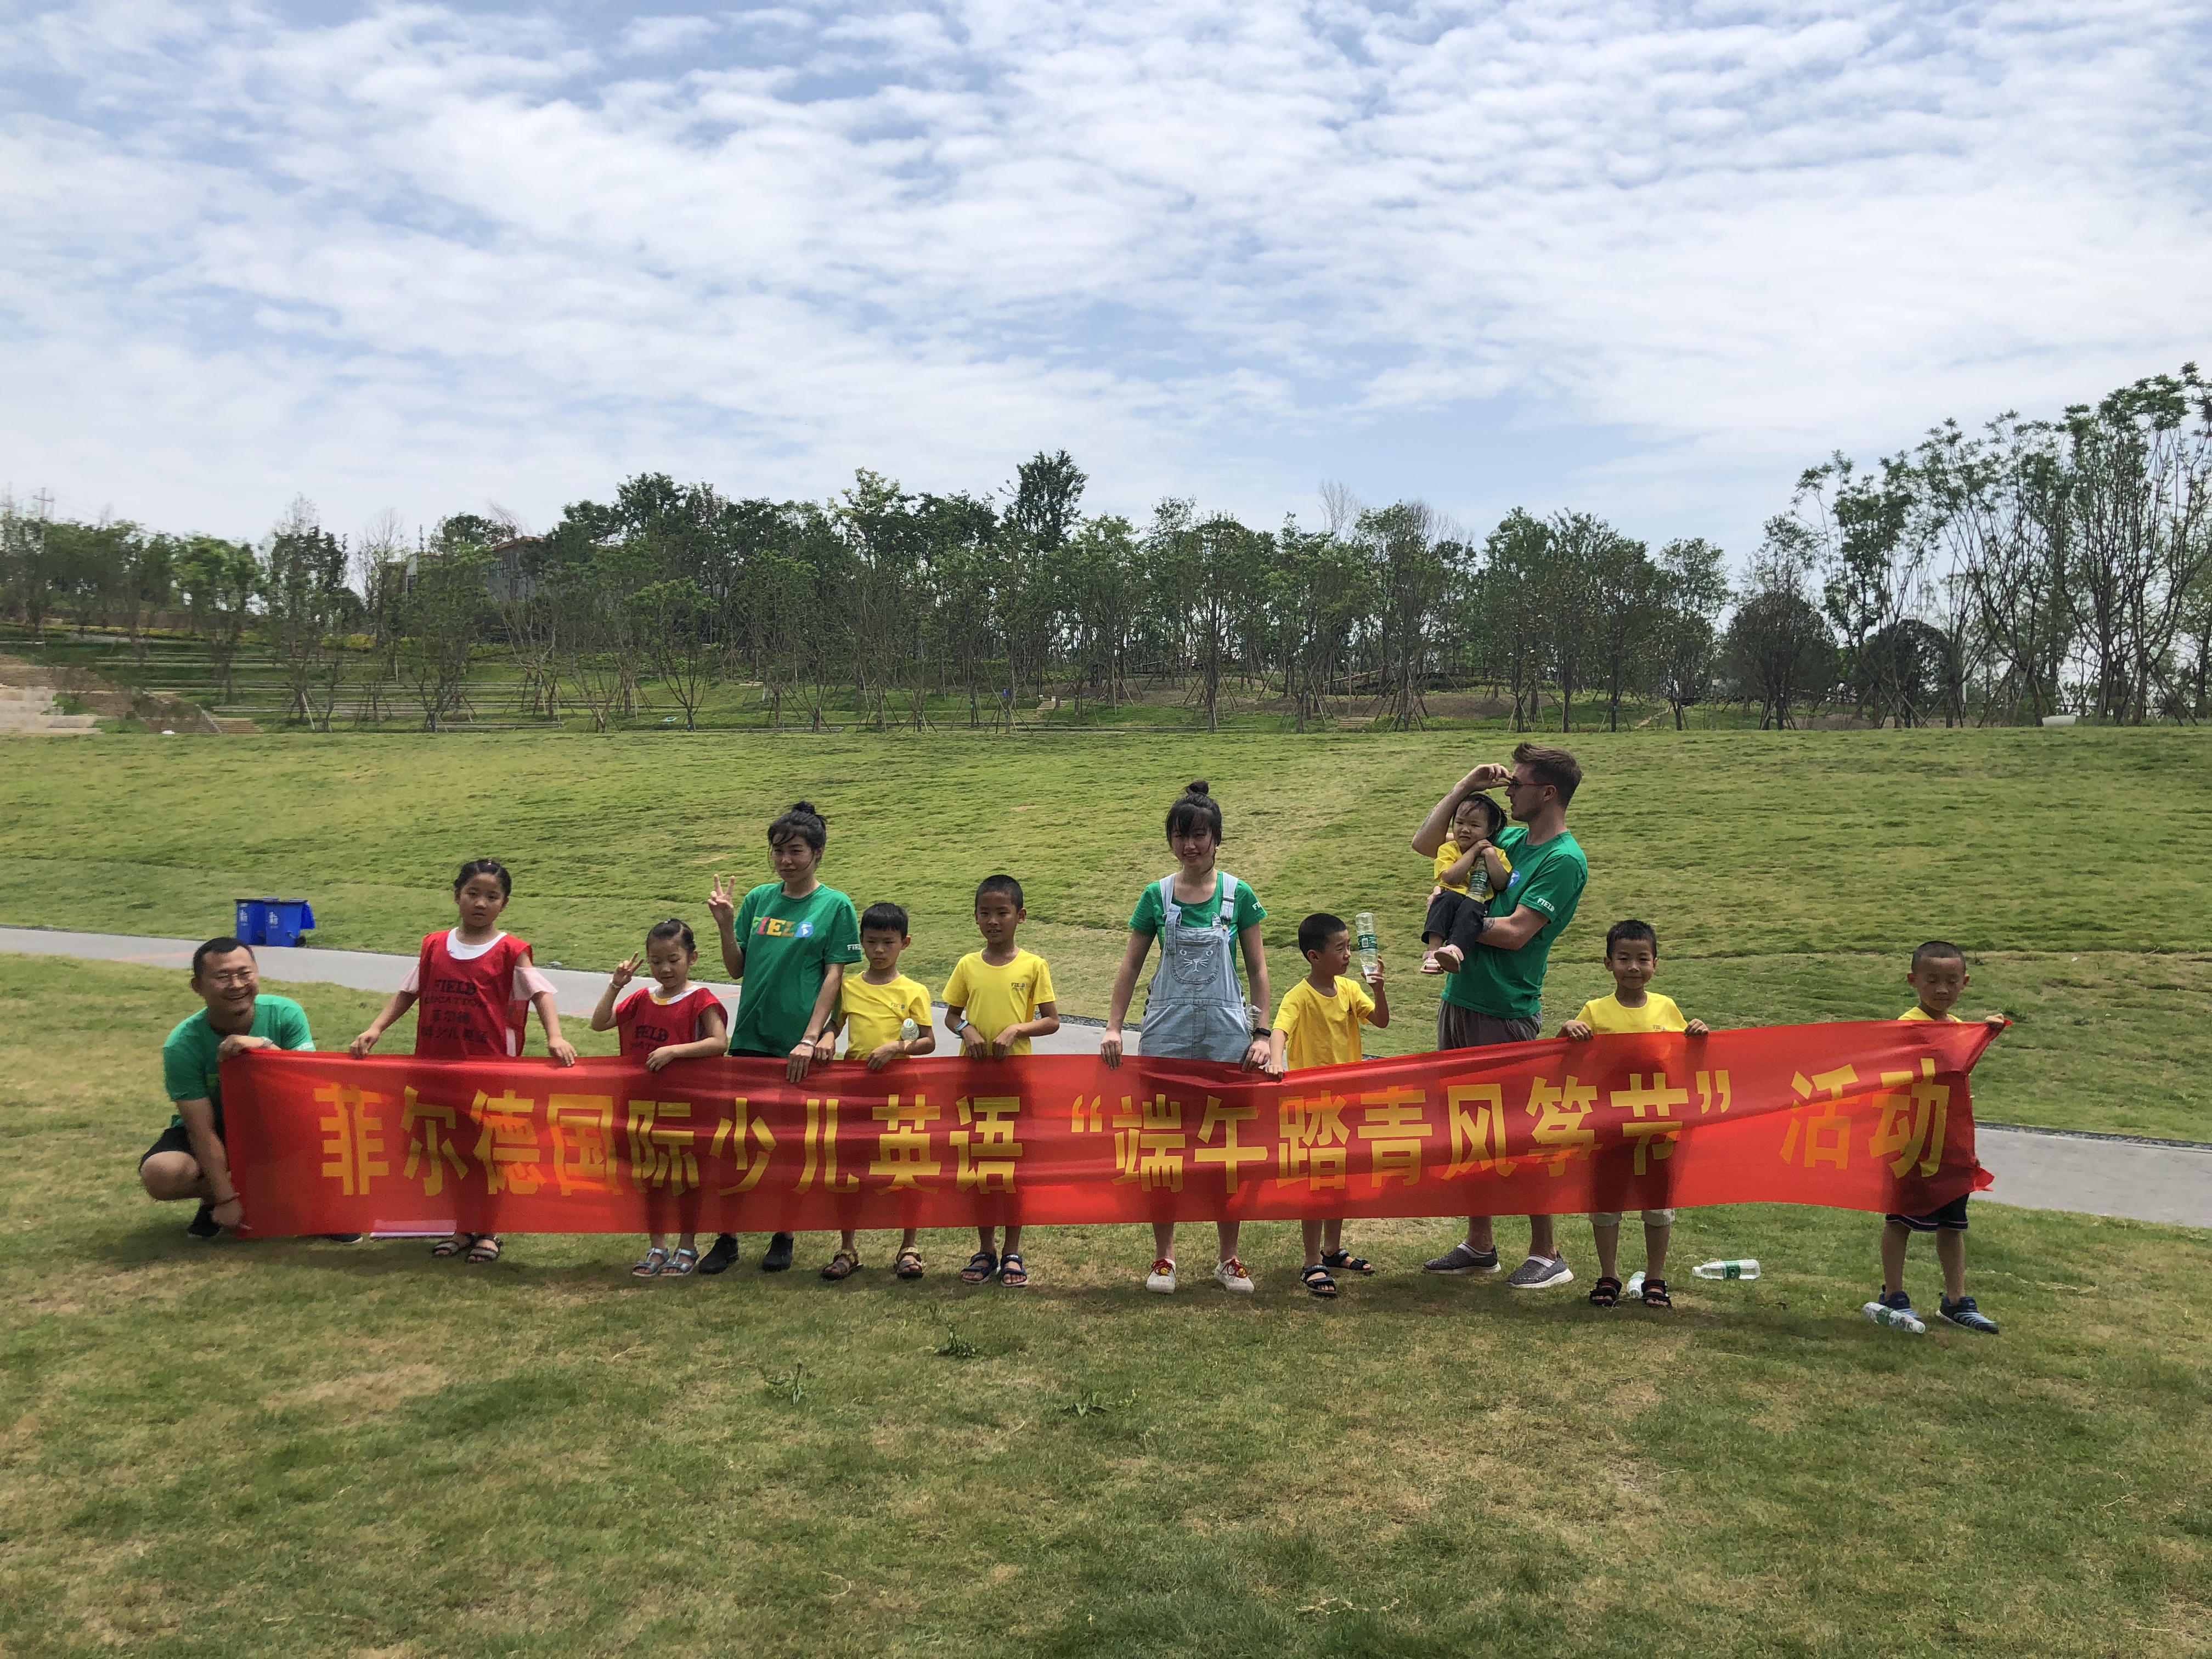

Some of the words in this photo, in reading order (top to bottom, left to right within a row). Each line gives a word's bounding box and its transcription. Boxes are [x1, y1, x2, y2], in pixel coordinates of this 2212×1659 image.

[1537, 898, 1554, 912] FIELD
[752, 916, 814, 938] FIELD
[635, 1025, 670, 1042] FELD
